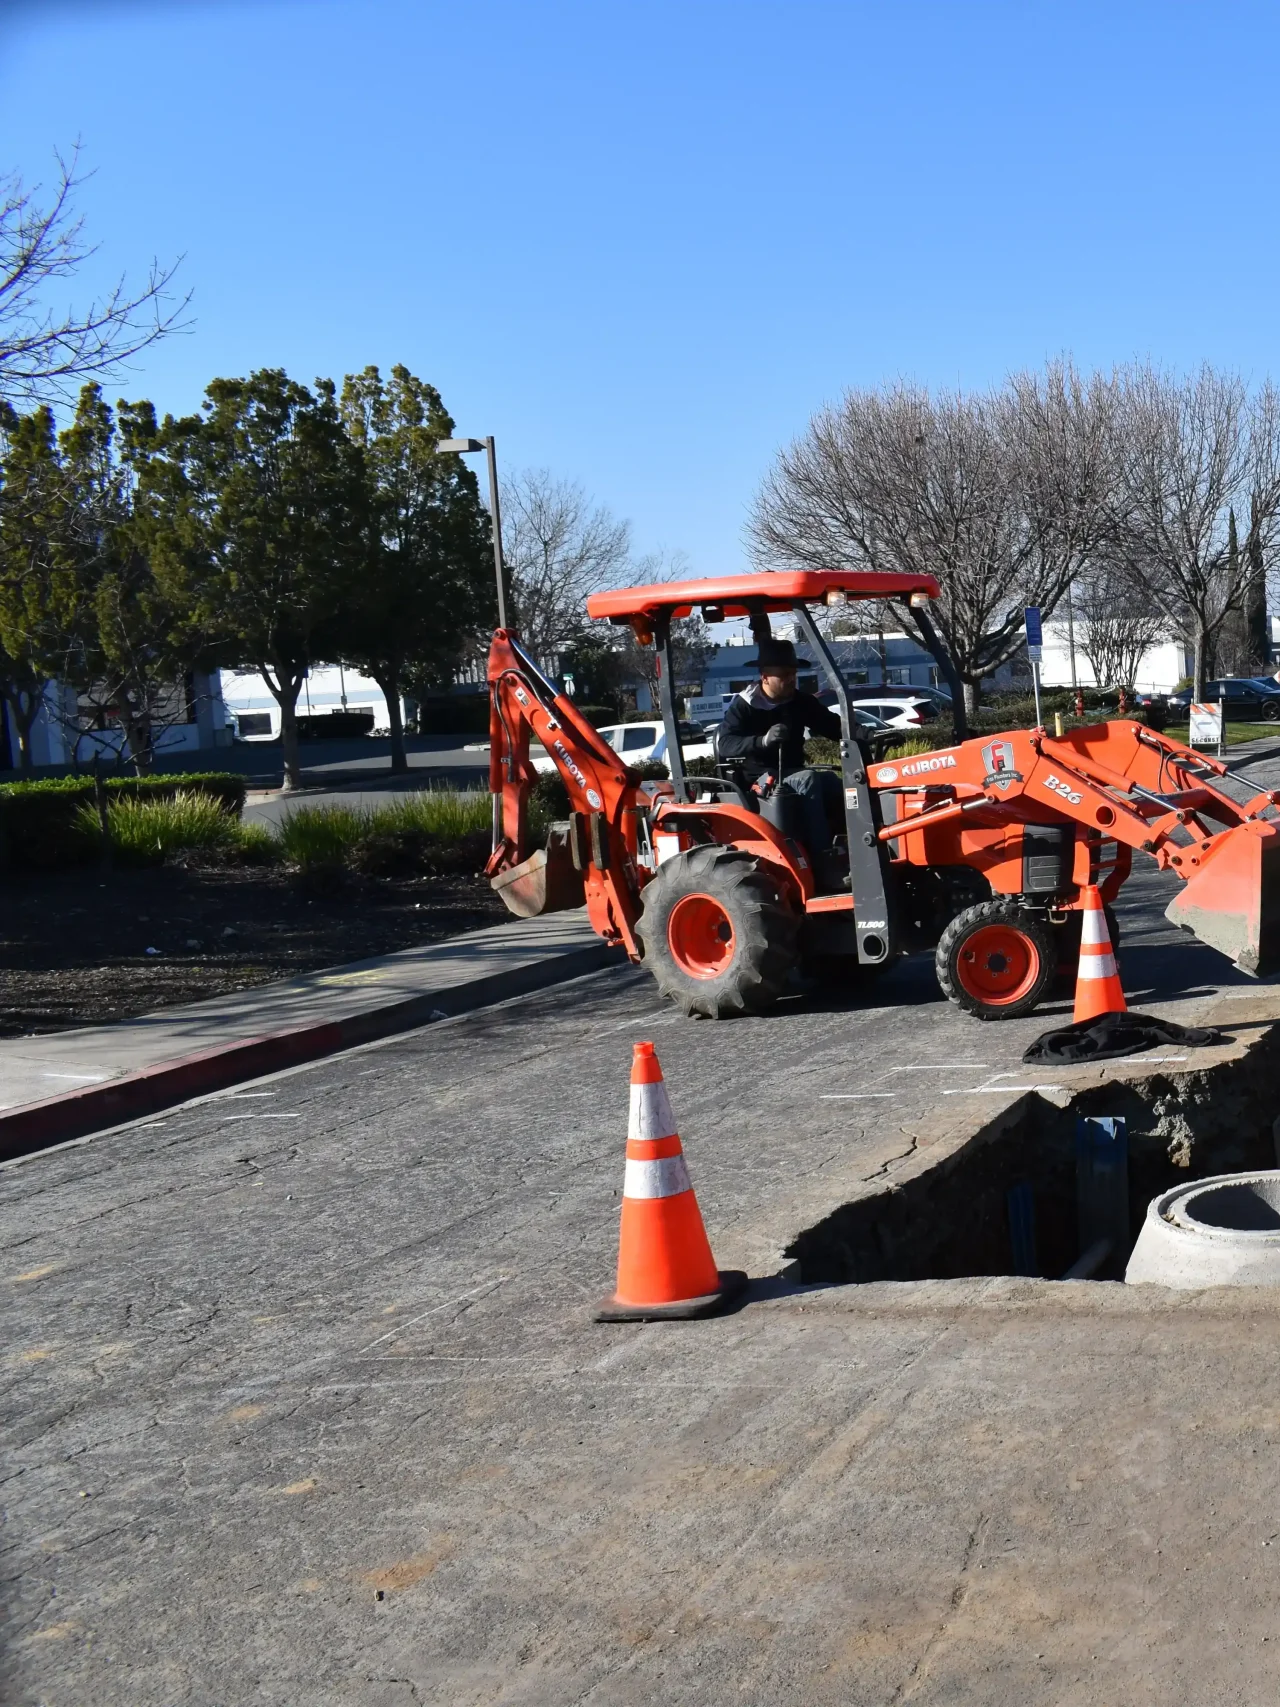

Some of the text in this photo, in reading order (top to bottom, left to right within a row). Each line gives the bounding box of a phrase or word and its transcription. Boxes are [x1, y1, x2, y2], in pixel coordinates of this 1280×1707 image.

[553, 739, 587, 788] KUBOTA
[901, 755, 957, 777] KUBOTA
[1042, 774, 1084, 805] B26
[857, 920, 886, 929] TL500
